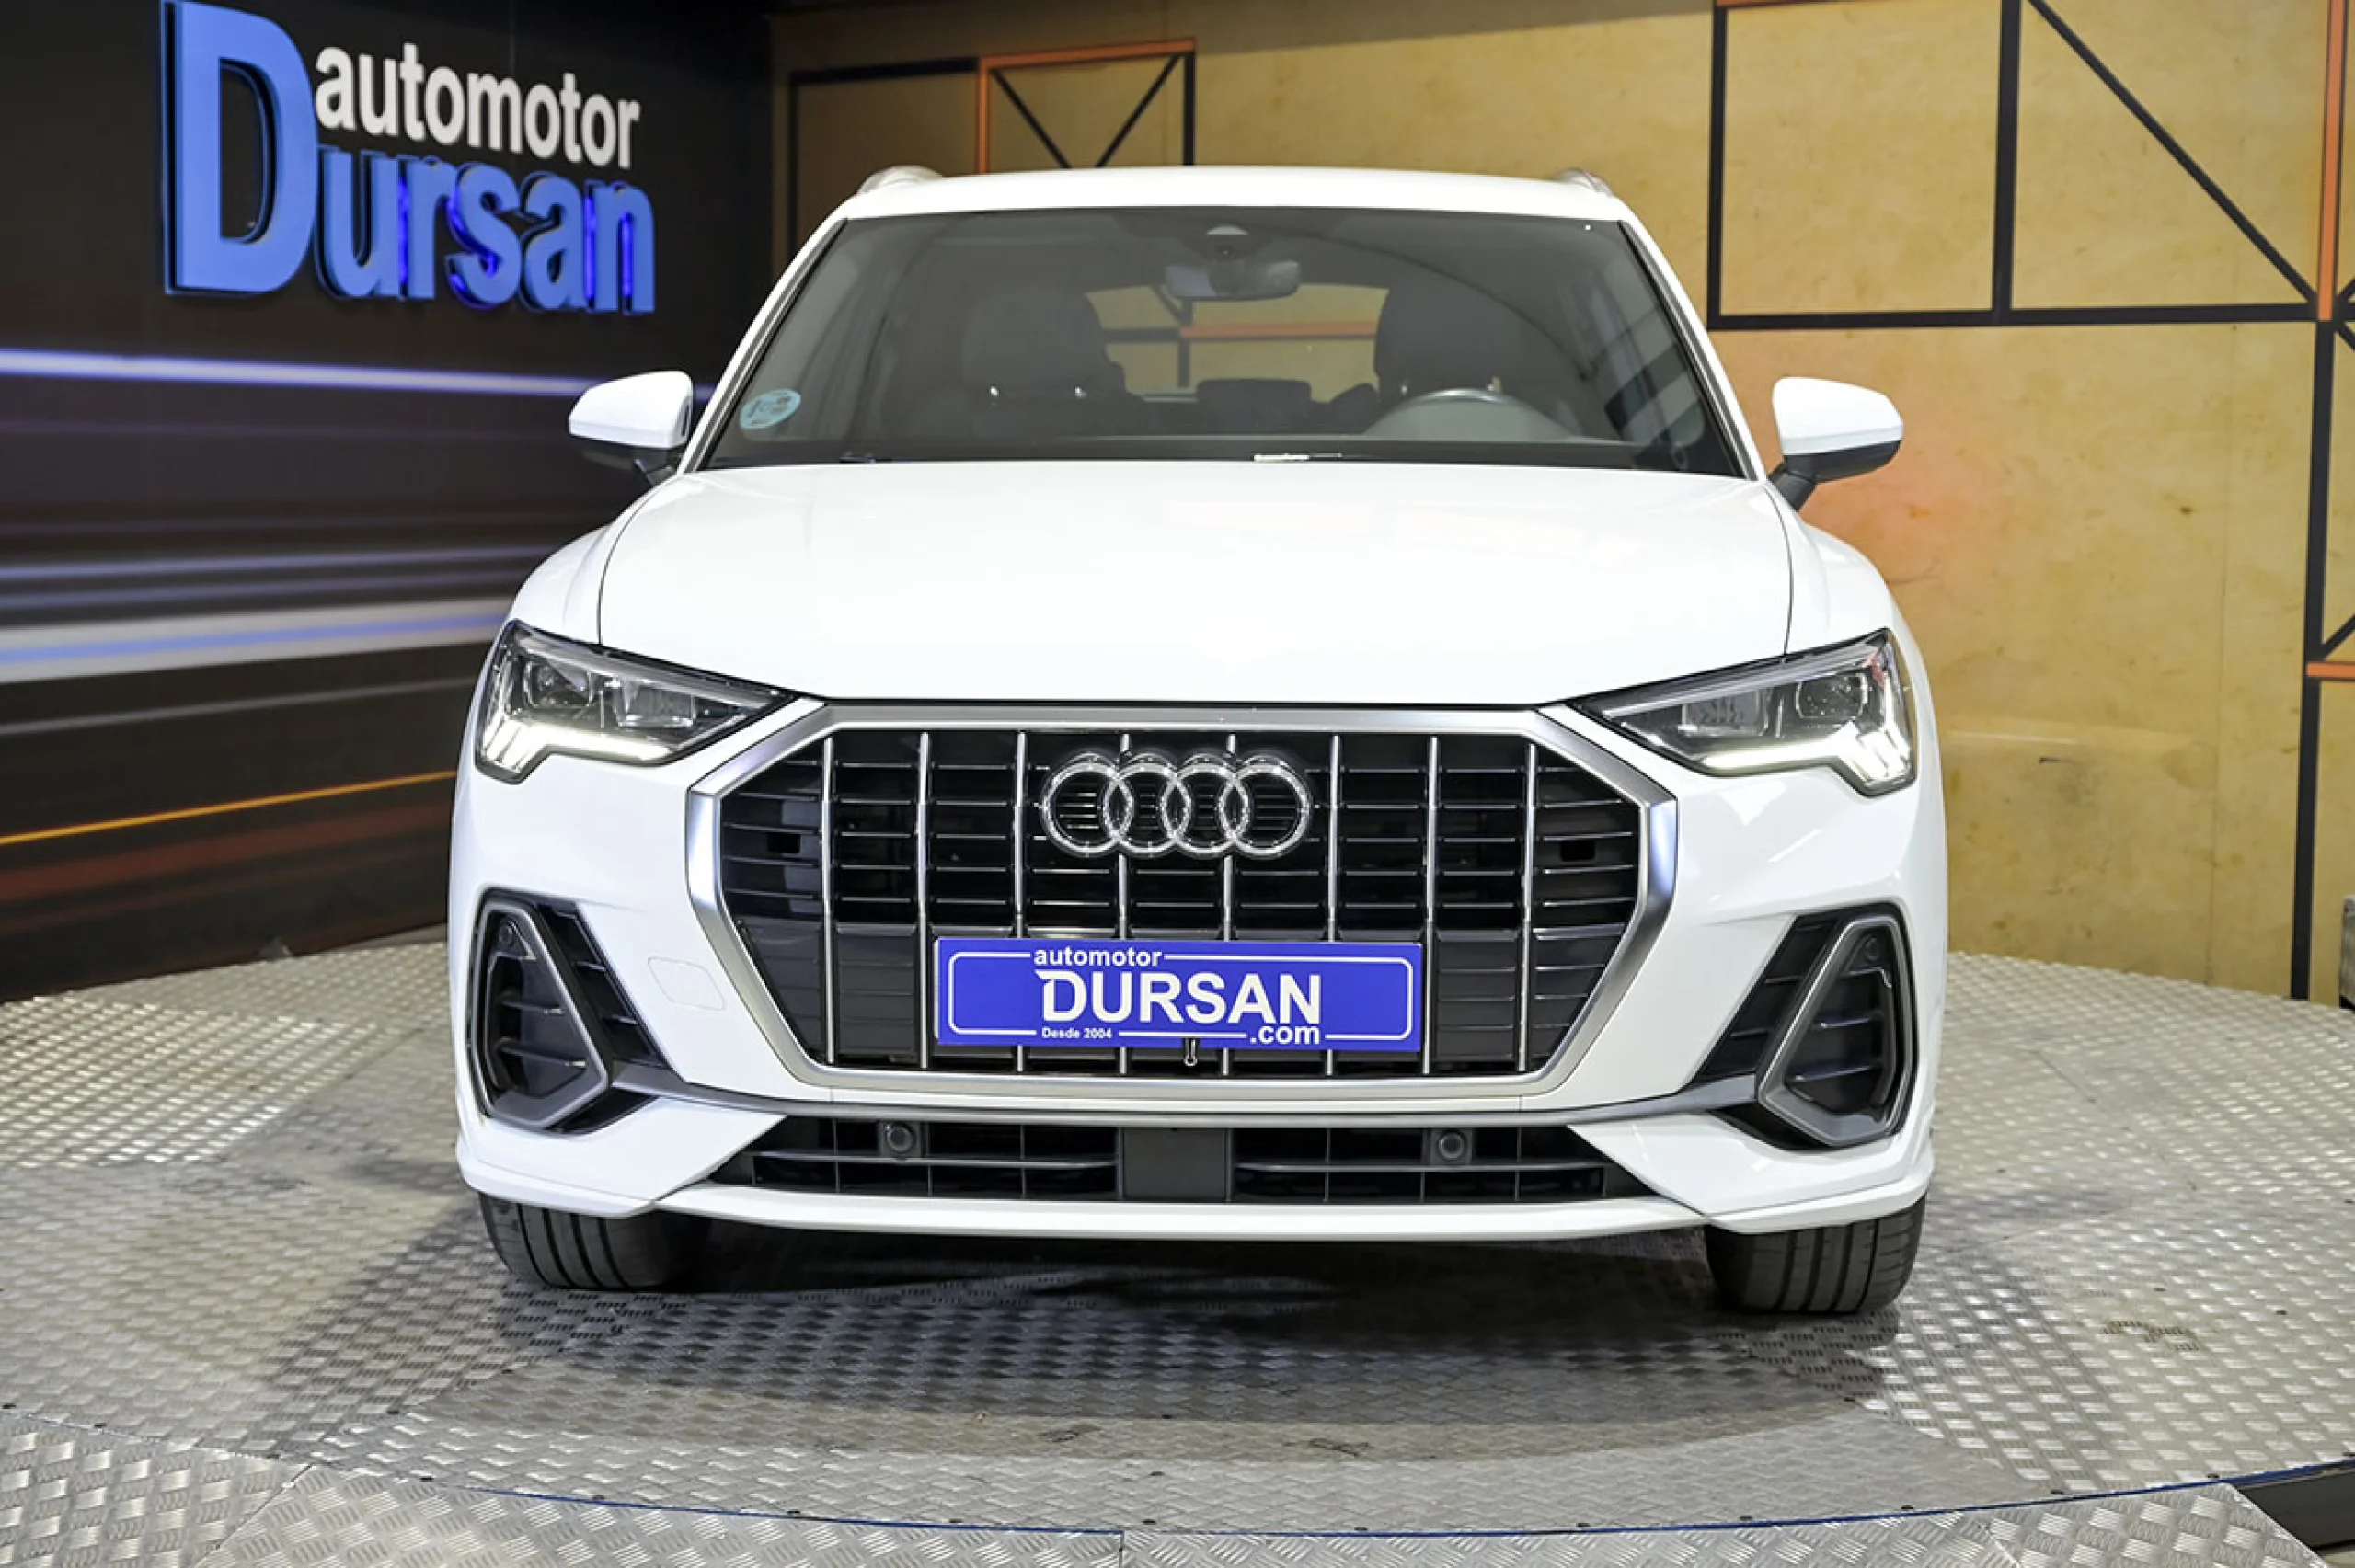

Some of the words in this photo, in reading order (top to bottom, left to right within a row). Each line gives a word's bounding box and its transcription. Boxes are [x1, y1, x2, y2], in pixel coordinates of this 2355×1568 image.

[316, 42, 640, 168] automotor
[161, 0, 656, 315] Dursan
[1033, 946, 1163, 967] automotor
[1035, 969, 1321, 1025] DURSAN
[1041, 1025, 1081, 1039] Desde
[1083, 1027, 1113, 1039] 2004
[1249, 1023, 1320, 1045] .com
